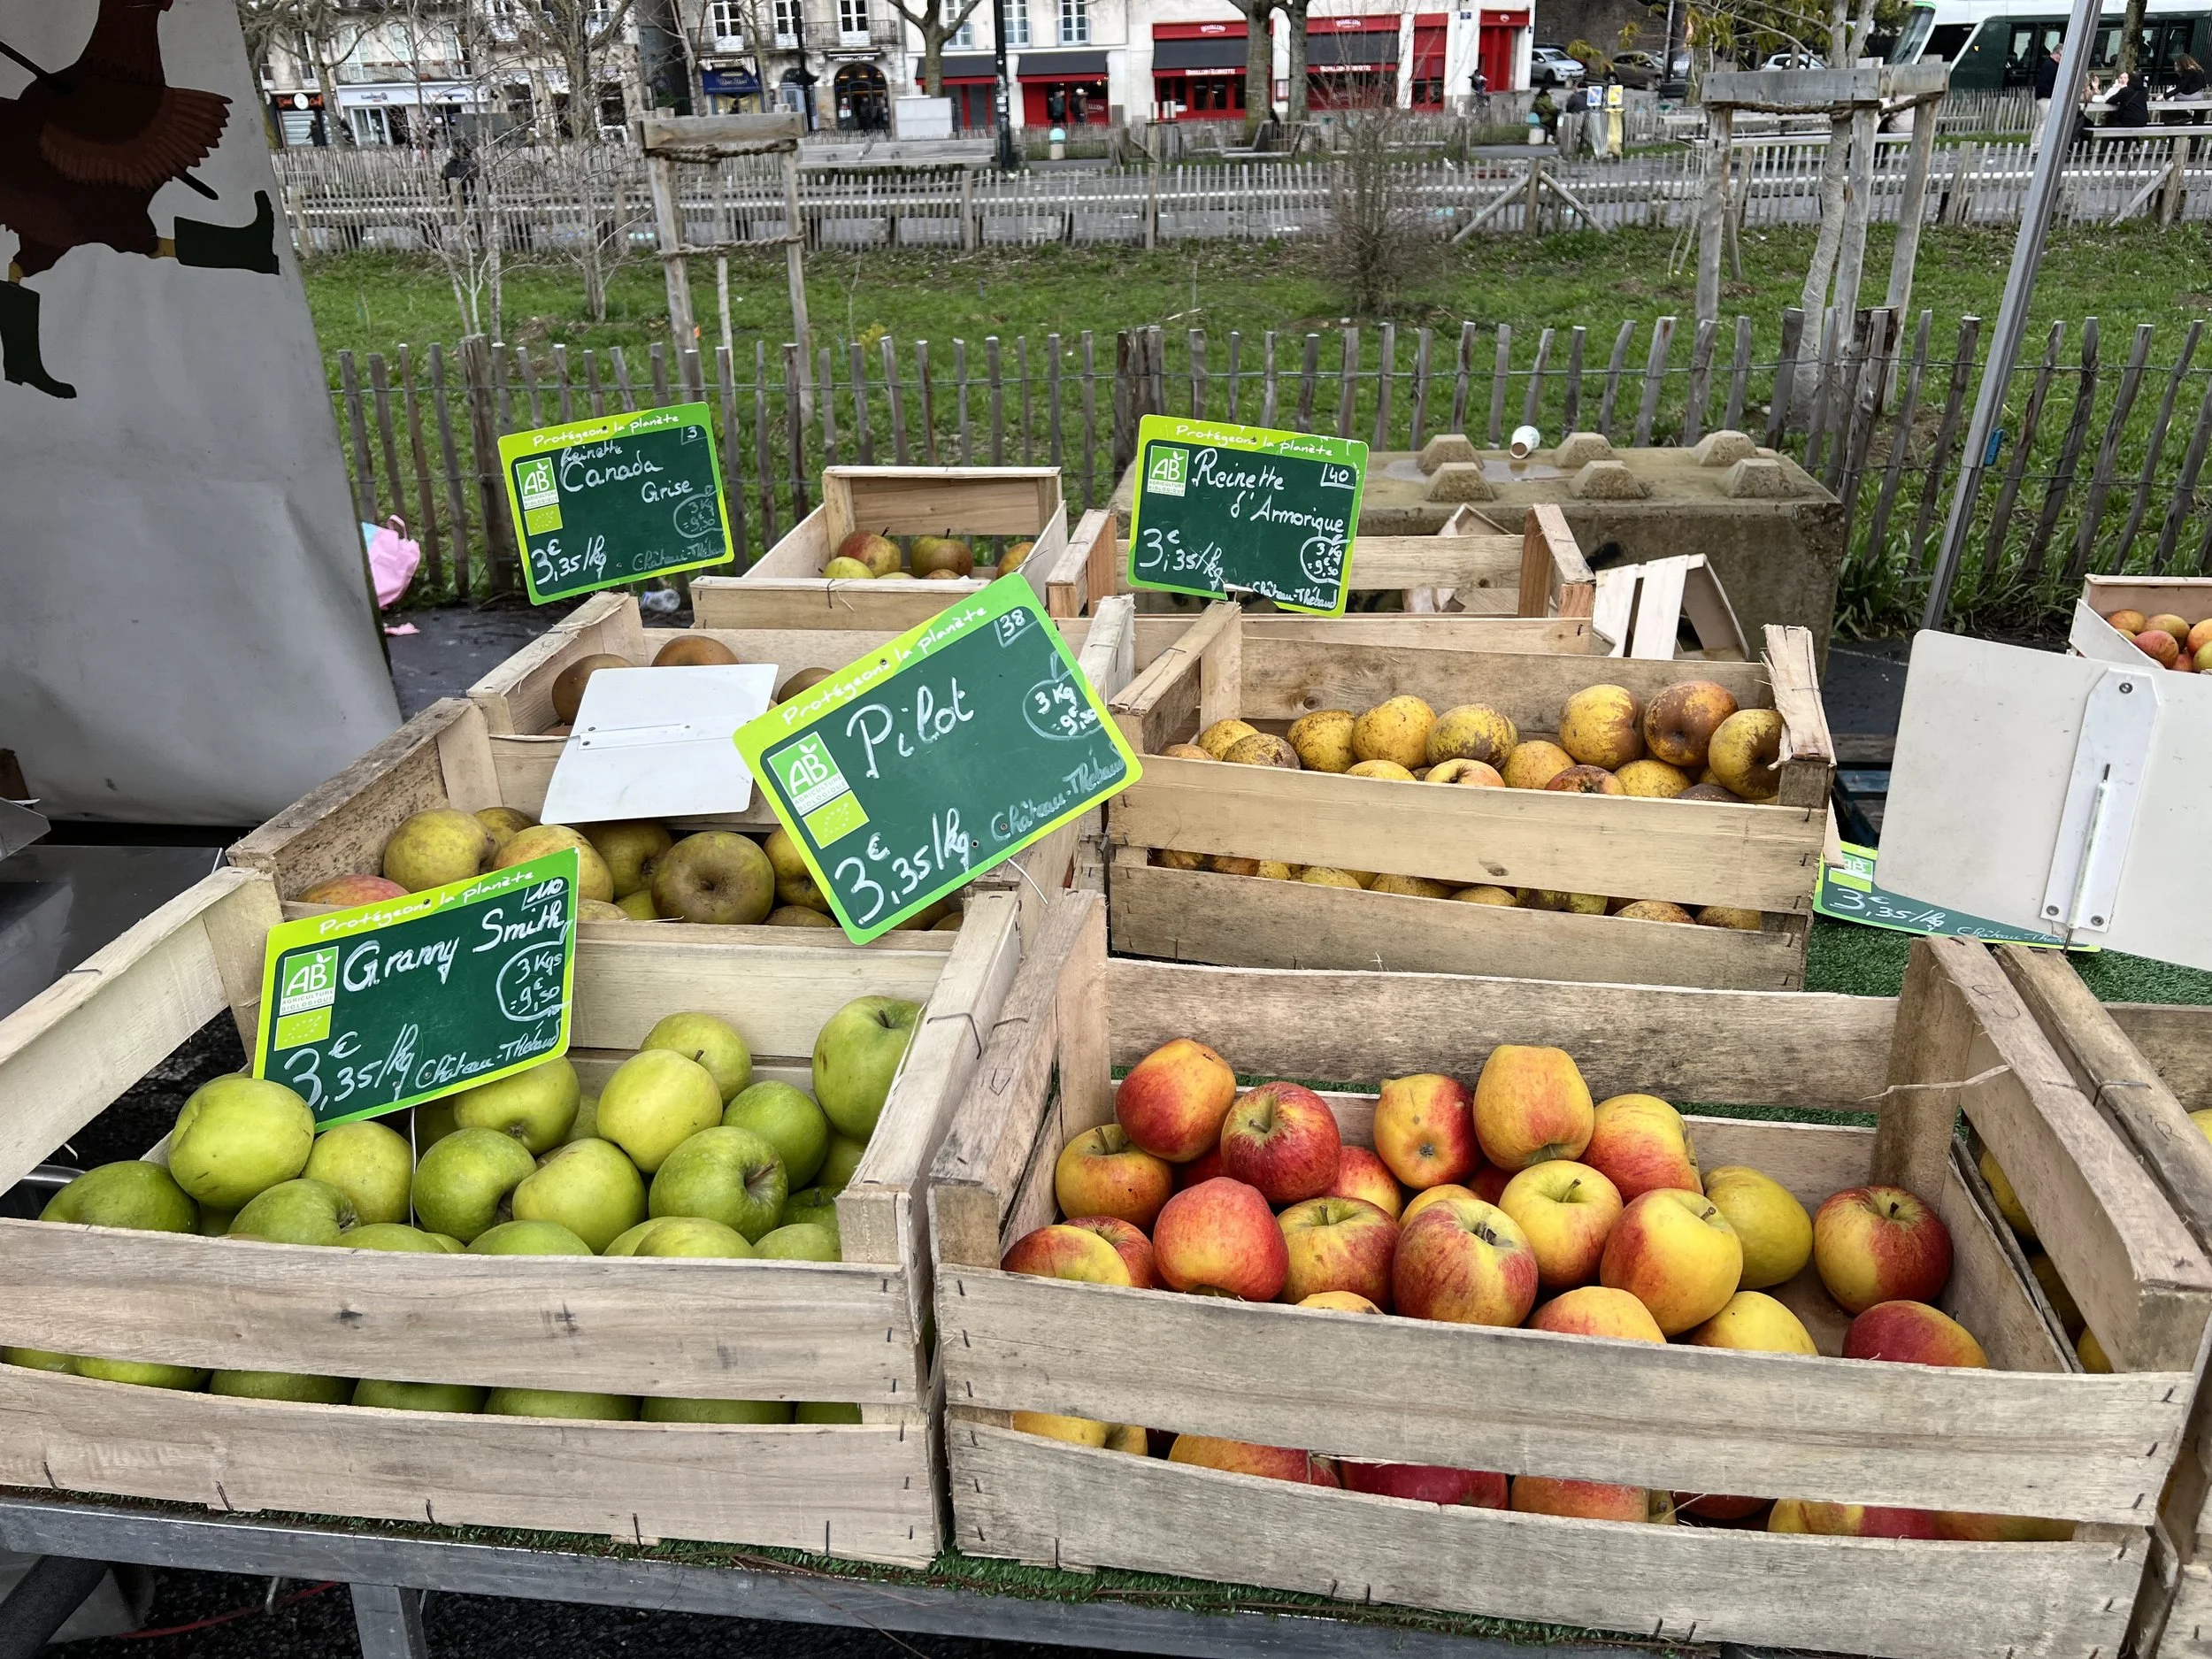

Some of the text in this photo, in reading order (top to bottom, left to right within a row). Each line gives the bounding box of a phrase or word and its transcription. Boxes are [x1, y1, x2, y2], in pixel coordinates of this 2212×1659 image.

[533, 414, 680, 447] Protégeons la planète
[1176, 425, 1333, 457] Protégeons la planète
[524, 470, 550, 495] AB
[559, 450, 664, 493] Canada
[1151, 458, 1181, 481] AB
[1191, 448, 1284, 491] Reinette
[641, 480, 693, 503] Grise
[1000, 609, 1025, 637] 38
[781, 606, 987, 726] Protégeons la planète
[845, 677, 974, 780] Pilot
[789, 753, 828, 795] AB
[319, 871, 535, 935] Protégeons la planète
[342, 899, 565, 992] Granny Smith
[286, 963, 328, 996] AB
[281, 988, 334, 1005] AGRICULTURE
